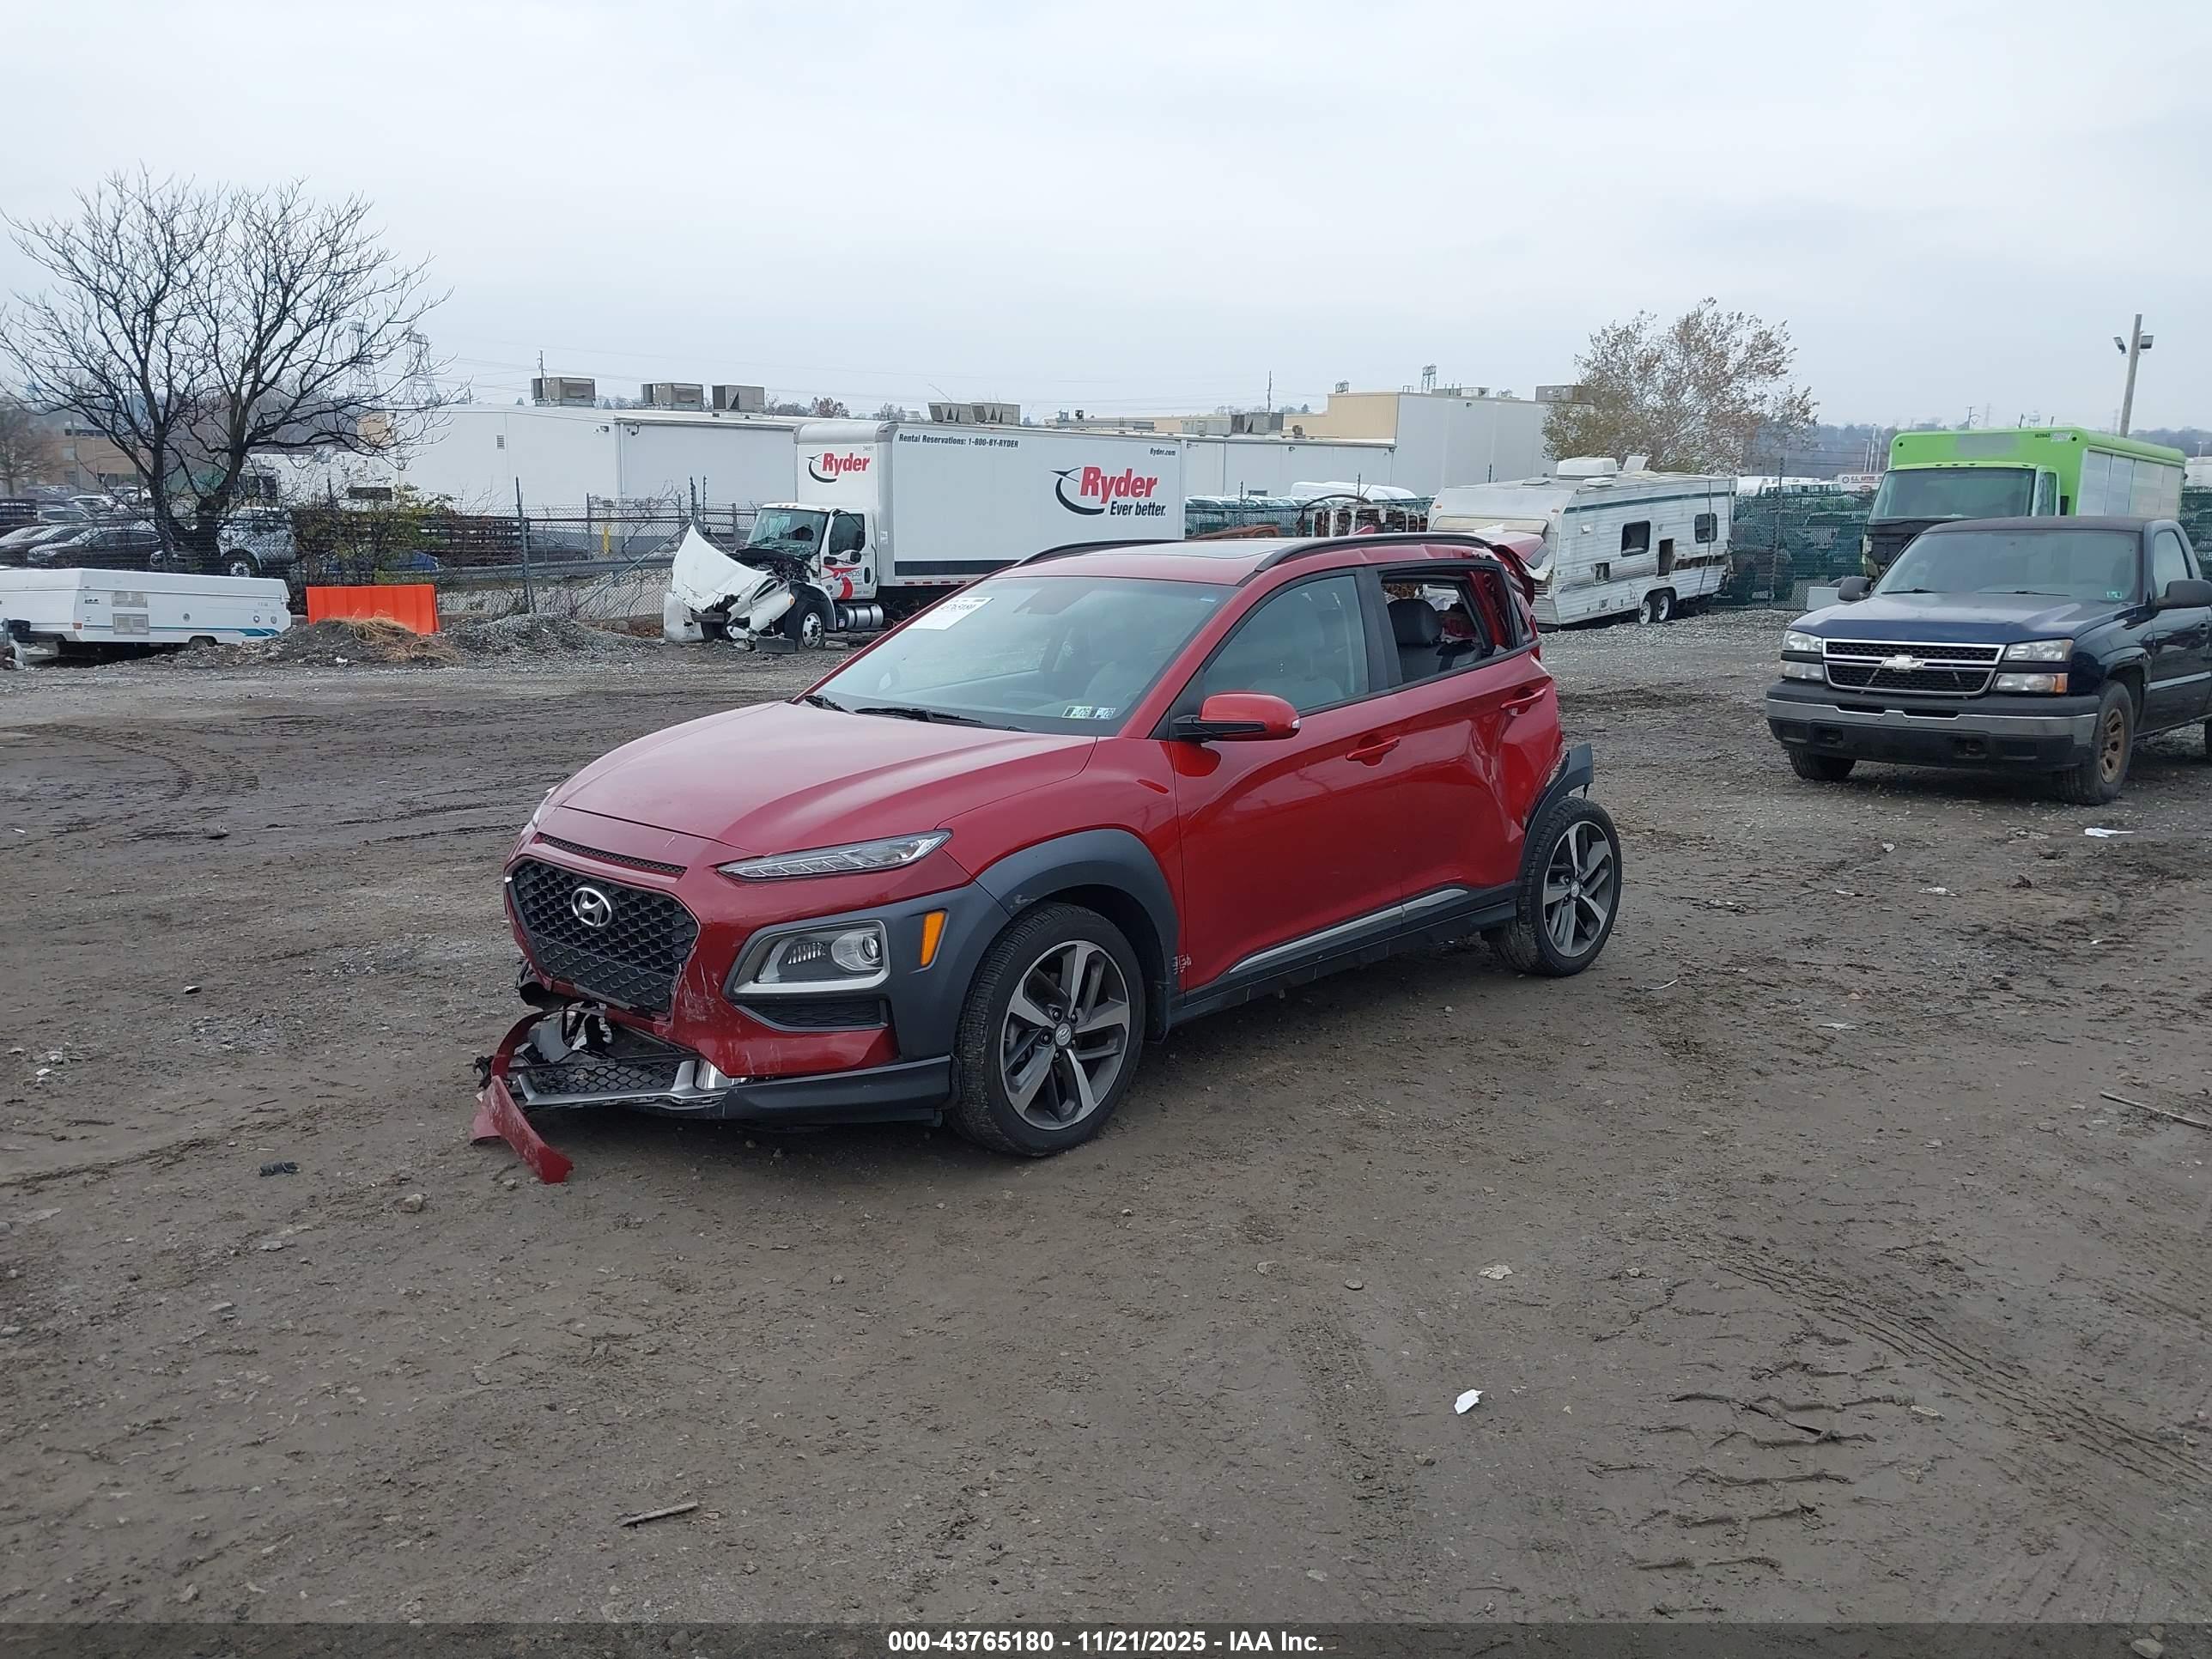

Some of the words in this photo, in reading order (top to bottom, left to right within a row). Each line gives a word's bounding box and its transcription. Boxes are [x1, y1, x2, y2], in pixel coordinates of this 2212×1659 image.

[899, 434, 921, 443] Rental
[922, 435, 966, 446] Reservations:
[968, 438, 1019, 448] 1-800-BY-RYDER
[1149, 447, 1176, 457] Ryder.com
[822, 453, 871, 476] Ryder
[1079, 466, 1158, 504] Ryder
[1109, 501, 1133, 516] Ever
[1134, 501, 1166, 517] better.
